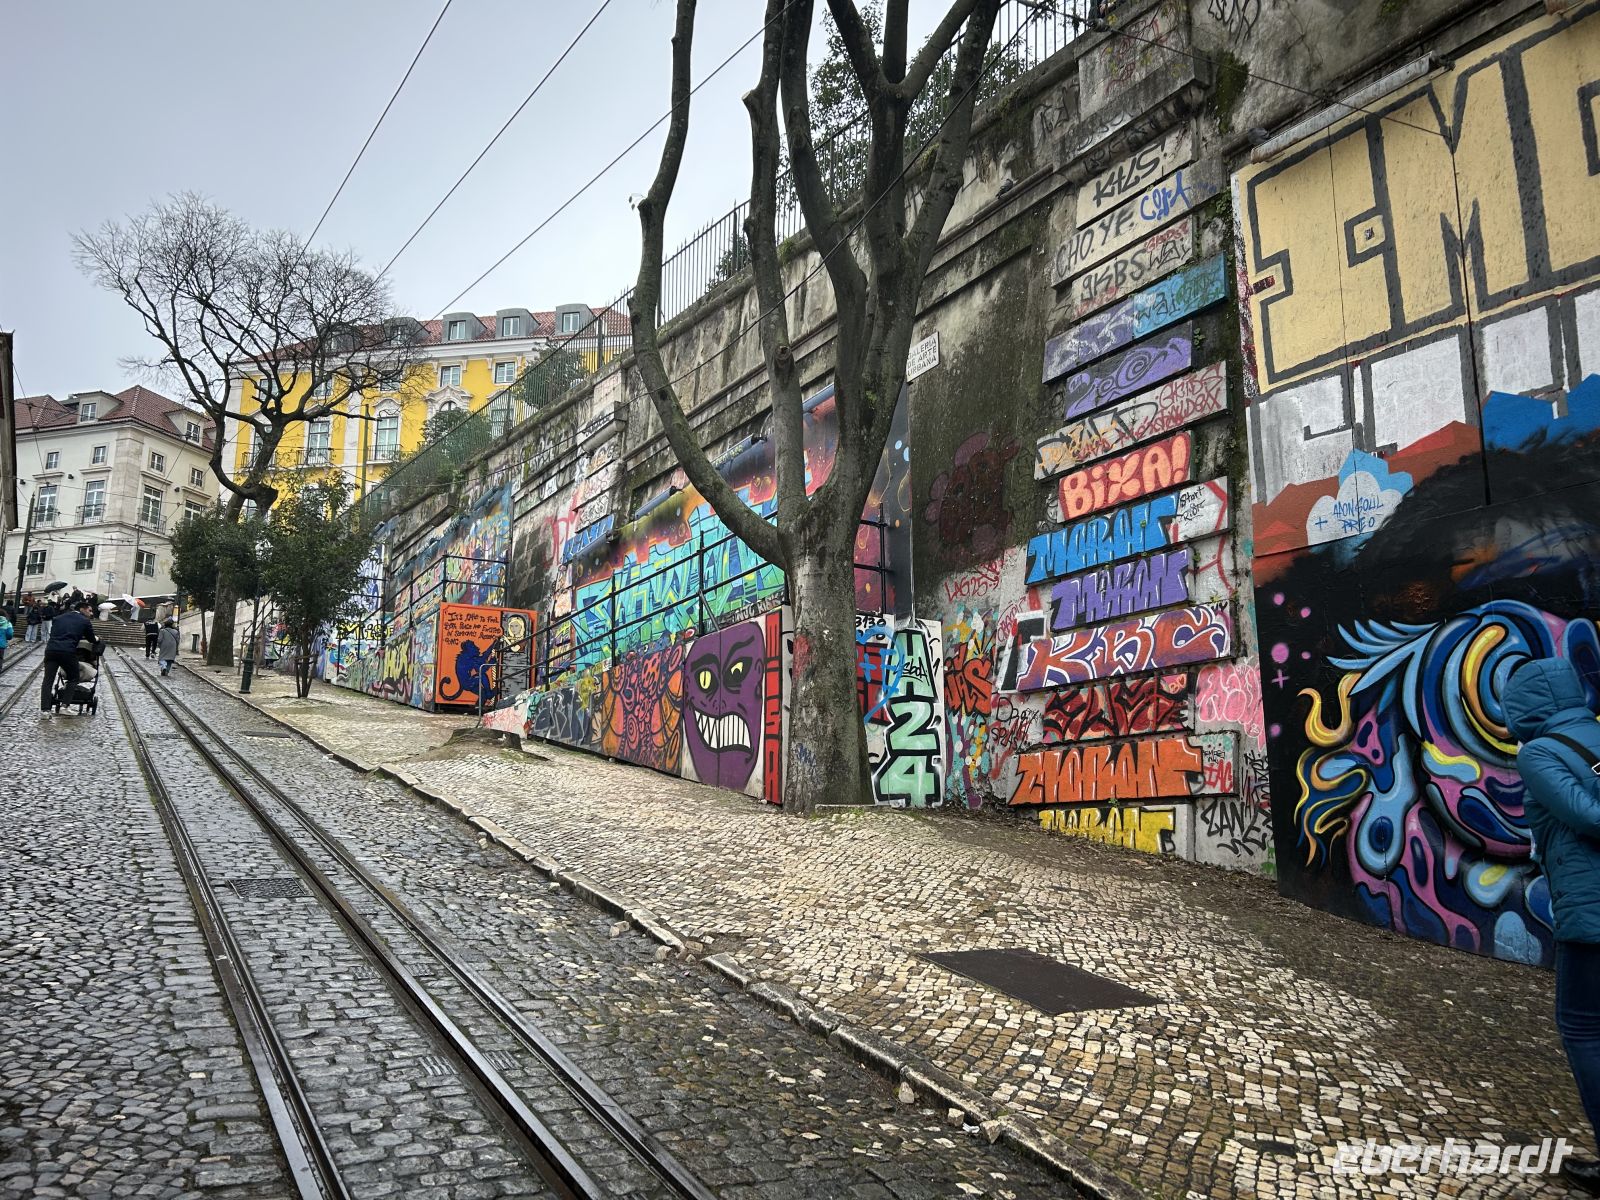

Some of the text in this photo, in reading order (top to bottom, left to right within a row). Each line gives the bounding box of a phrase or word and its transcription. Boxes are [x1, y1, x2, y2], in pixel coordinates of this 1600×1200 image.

[907, 345, 937, 369] DE ARTE
[907, 355, 937, 377] URBANA
